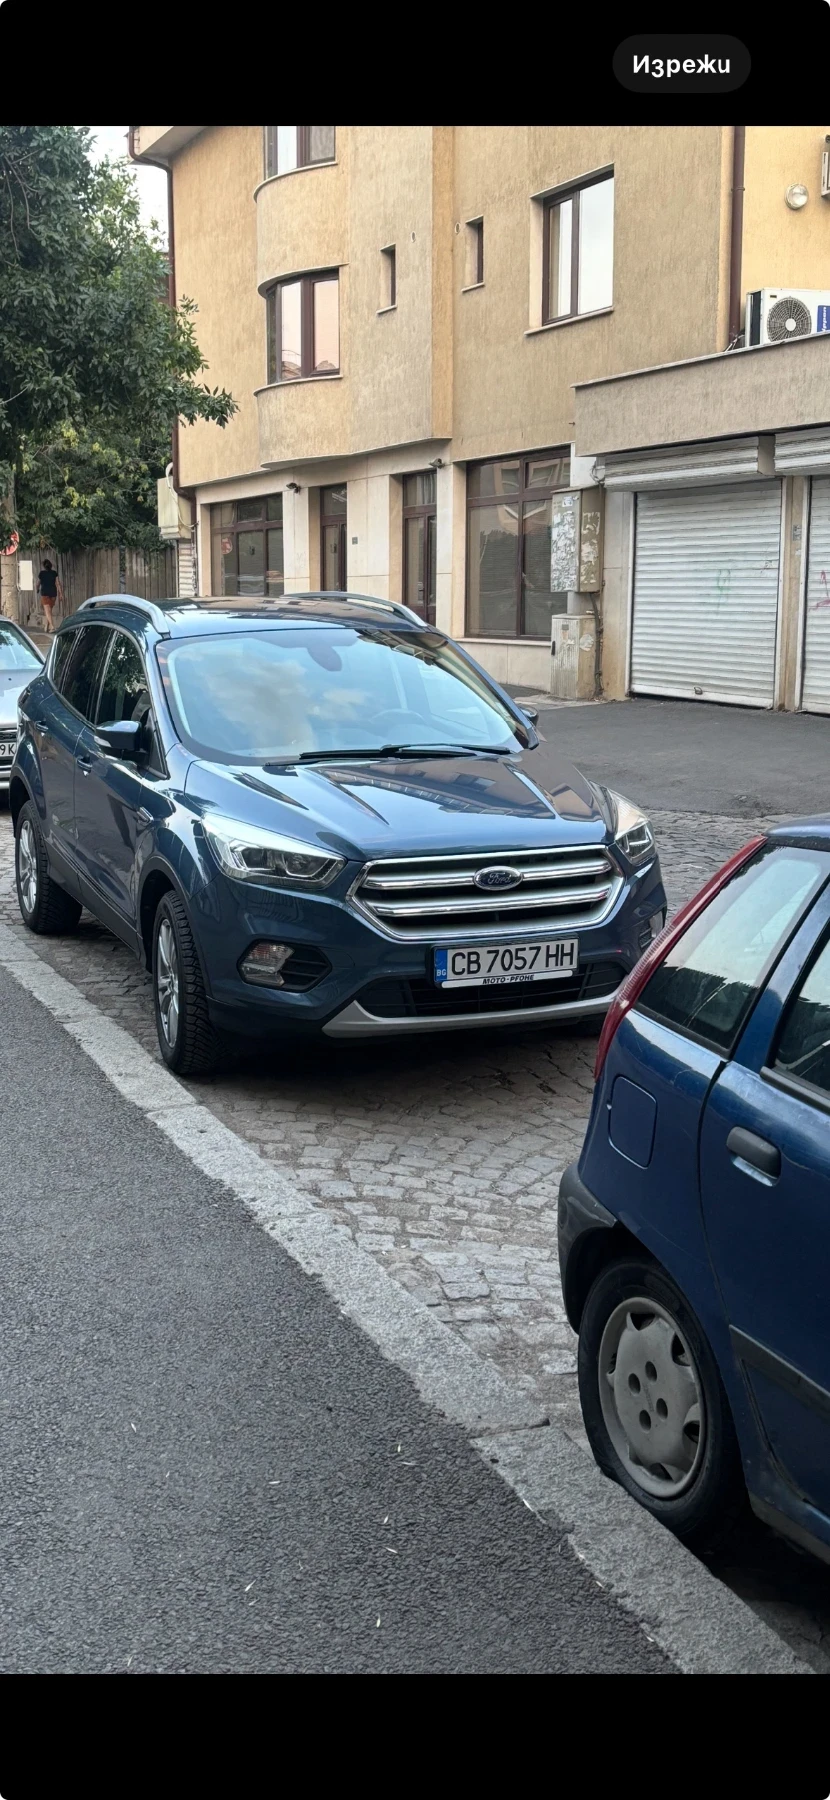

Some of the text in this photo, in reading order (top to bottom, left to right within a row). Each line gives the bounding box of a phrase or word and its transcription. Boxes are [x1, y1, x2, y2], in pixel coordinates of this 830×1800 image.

[488, 872, 512, 885] Ford
[451, 943, 575, 976] CB 7057 HH
[436, 968, 447, 976] BG
